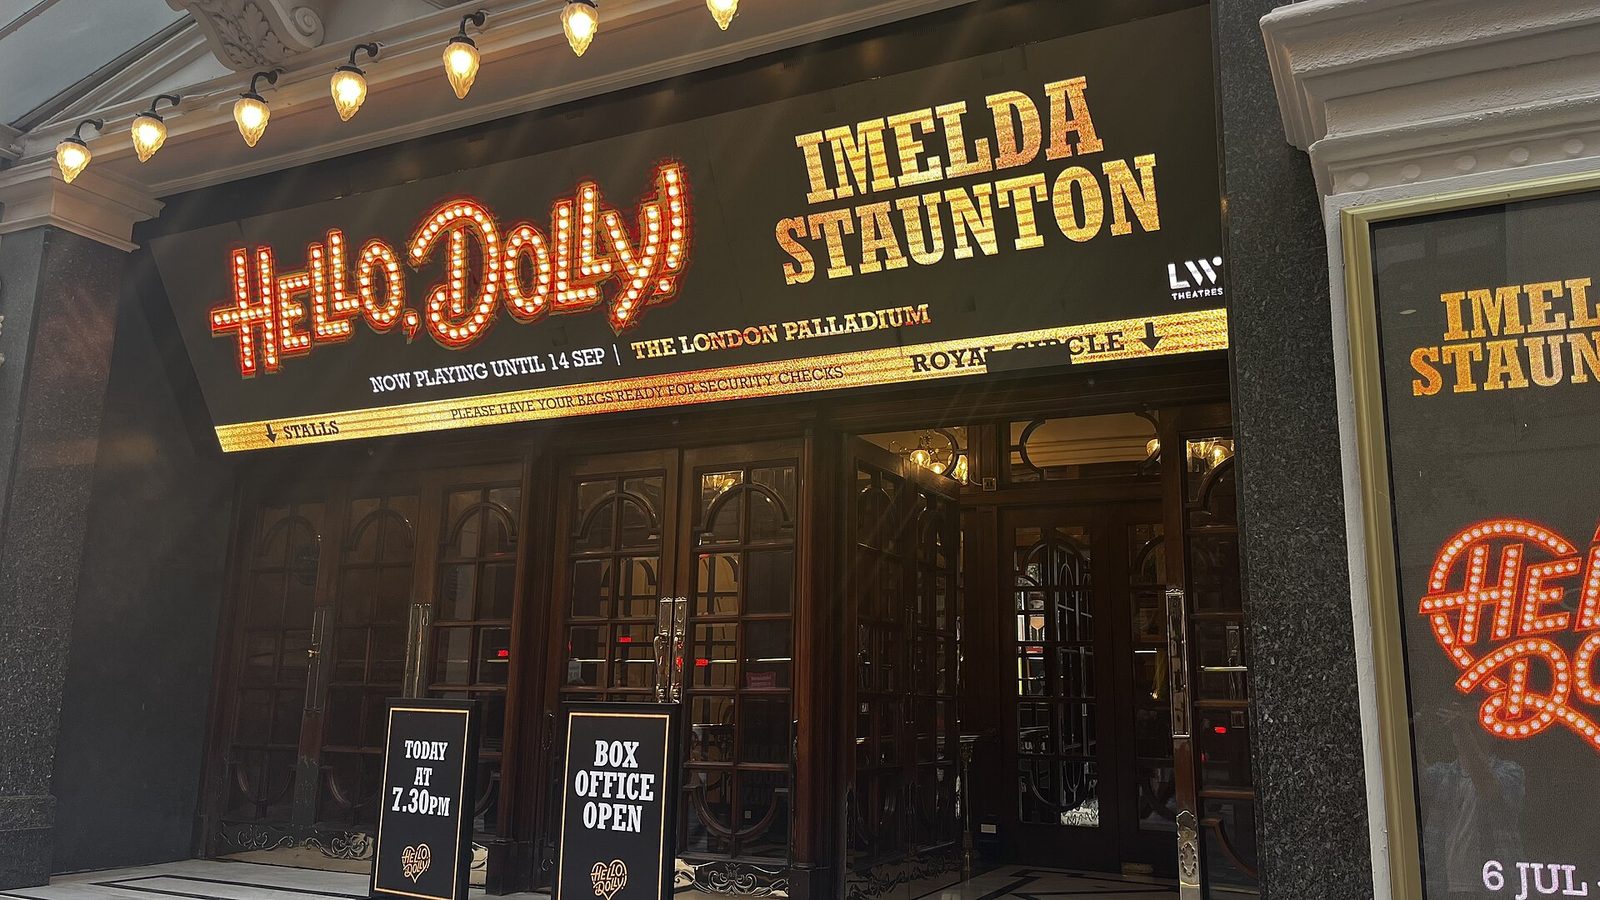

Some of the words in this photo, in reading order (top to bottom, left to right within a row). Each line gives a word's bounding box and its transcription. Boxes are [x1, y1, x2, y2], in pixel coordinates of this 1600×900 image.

[795, 76, 1104, 204] IMELDA
[775, 153, 1160, 286] STAUNTON
[408, 160, 687, 350] DOLLY!
[1171, 287, 1223, 300] THEATRES
[1440, 277, 1600, 341] IMEL
[369, 371, 411, 393] NOW
[415, 362, 488, 388] PLAYING
[490, 355, 545, 378] UNTIL
[548, 352, 570, 371] 14
[571, 347, 605, 368] SEP
[631, 337, 677, 360] THE
[680, 323, 778, 355] LONDON
[784, 303, 932, 341] PALLADIUM
[451, 405, 497, 421] PLEASE
[499, 400, 537, 416] HAVE
[538, 396, 574, 412] YOUR
[577, 391, 613, 407] BAGS
[617, 384, 663, 402] READY
[668, 382, 696, 397] FOR
[699, 373, 775, 394] SECURITY
[779, 366, 845, 385] CHECKS
[283, 420, 340, 440] STALLS
[404, 739, 449, 762] TODAY
[593, 740, 640, 769] BOX
[413, 766, 433, 787] AT
[574, 770, 655, 802] OFFICE
[391, 786, 450, 817] 7.30PM
[582, 802, 643, 834] OPEN
[1482, 860, 1505, 891] 6
[1514, 862, 1588, 900] JUL
